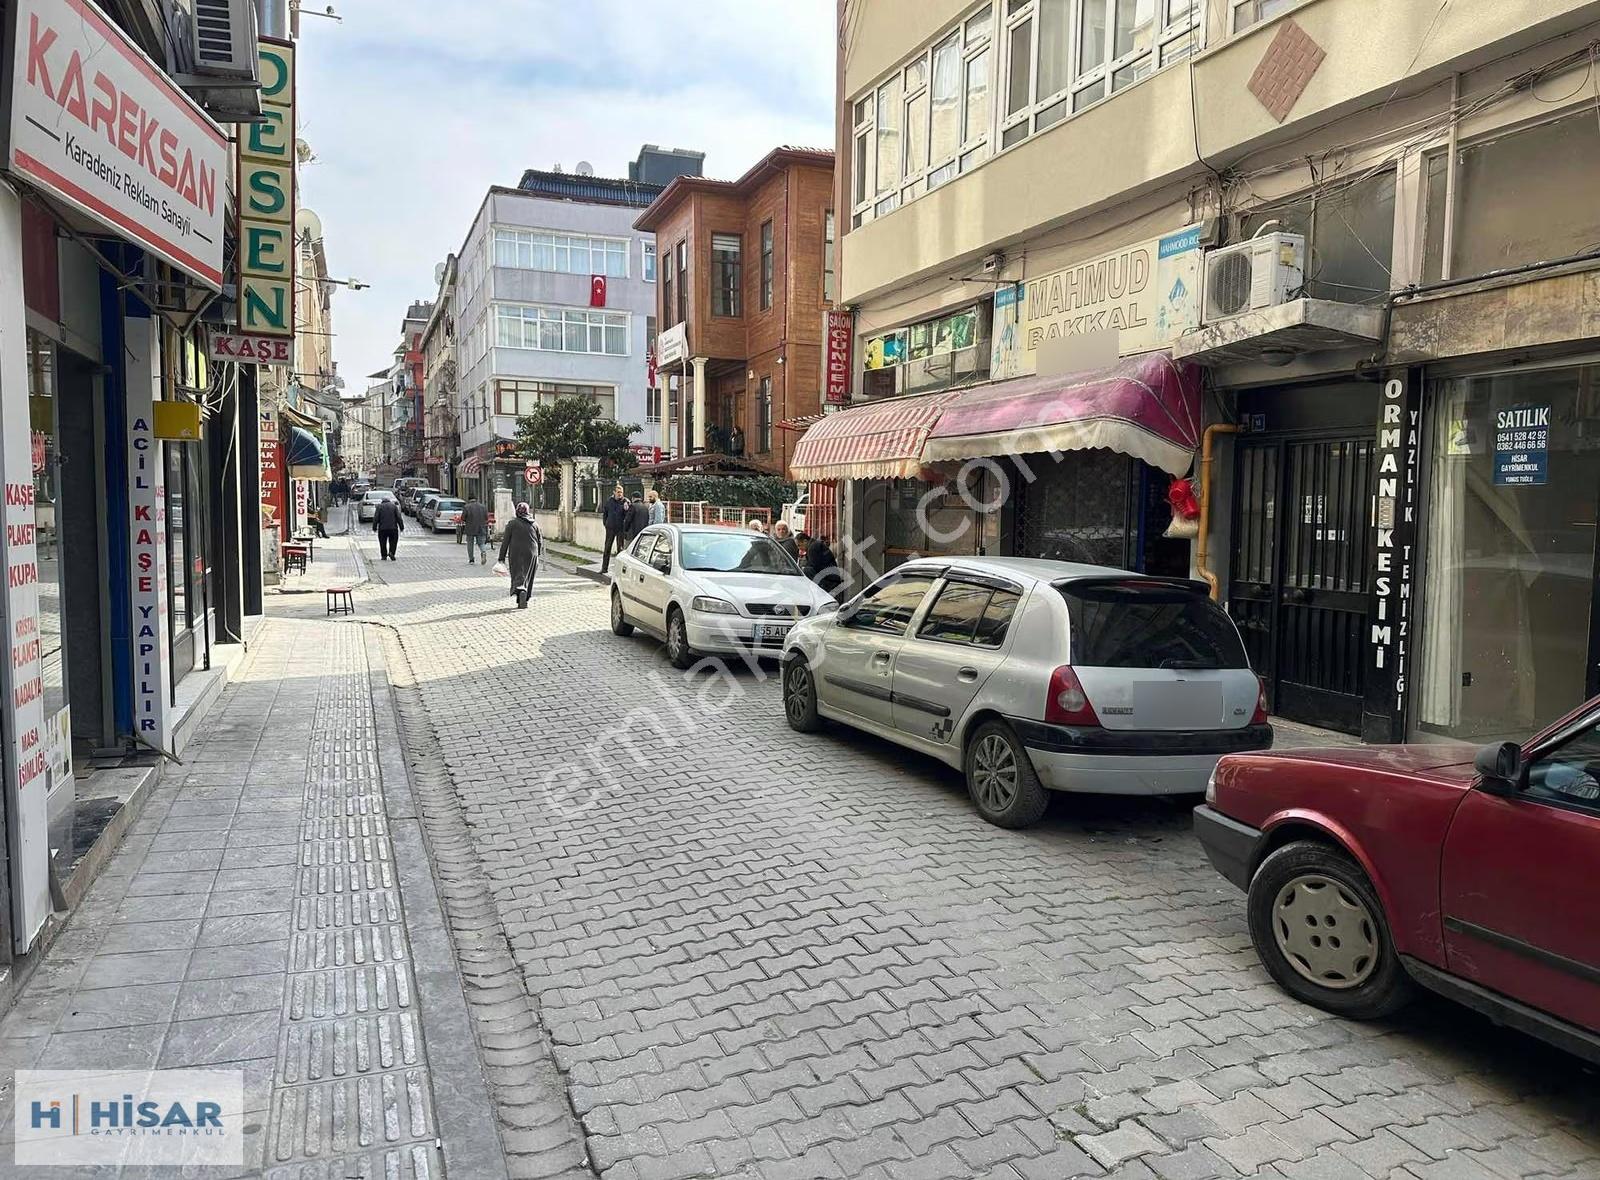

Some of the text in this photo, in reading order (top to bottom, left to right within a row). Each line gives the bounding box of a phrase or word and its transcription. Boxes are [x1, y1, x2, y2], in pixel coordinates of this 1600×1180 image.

[26, 12, 216, 218] KAREKSAN
[64, 132, 192, 237] Karadeniz Reklam Sanayii
[247, 50, 288, 330] DESEN
[1027, 248, 1150, 322] MAHMUD
[829, 315, 851, 328] SALON
[1027, 302, 1147, 351] BAKKAL
[214, 336, 290, 364] KAŞE
[1497, 407, 1549, 429] SATILIK
[1497, 430, 1547, 442] 0541 528 42 92
[1379, 379, 1402, 497] ORMAN
[1497, 442, 1513, 451] 0362
[1514, 441, 1526, 450] 446
[6, 484, 33, 511] KAŞE
[8, 524, 35, 547] PLAKET
[9, 563, 37, 588] KUPA
[132, 417, 157, 732] ACİL KAŞE YAPILIR
[1396, 410, 1418, 711] YAZLIK TEMİZLİĞİ
[1372, 530, 1393, 668] KESİMİ
[21, 727, 39, 753] MASA
